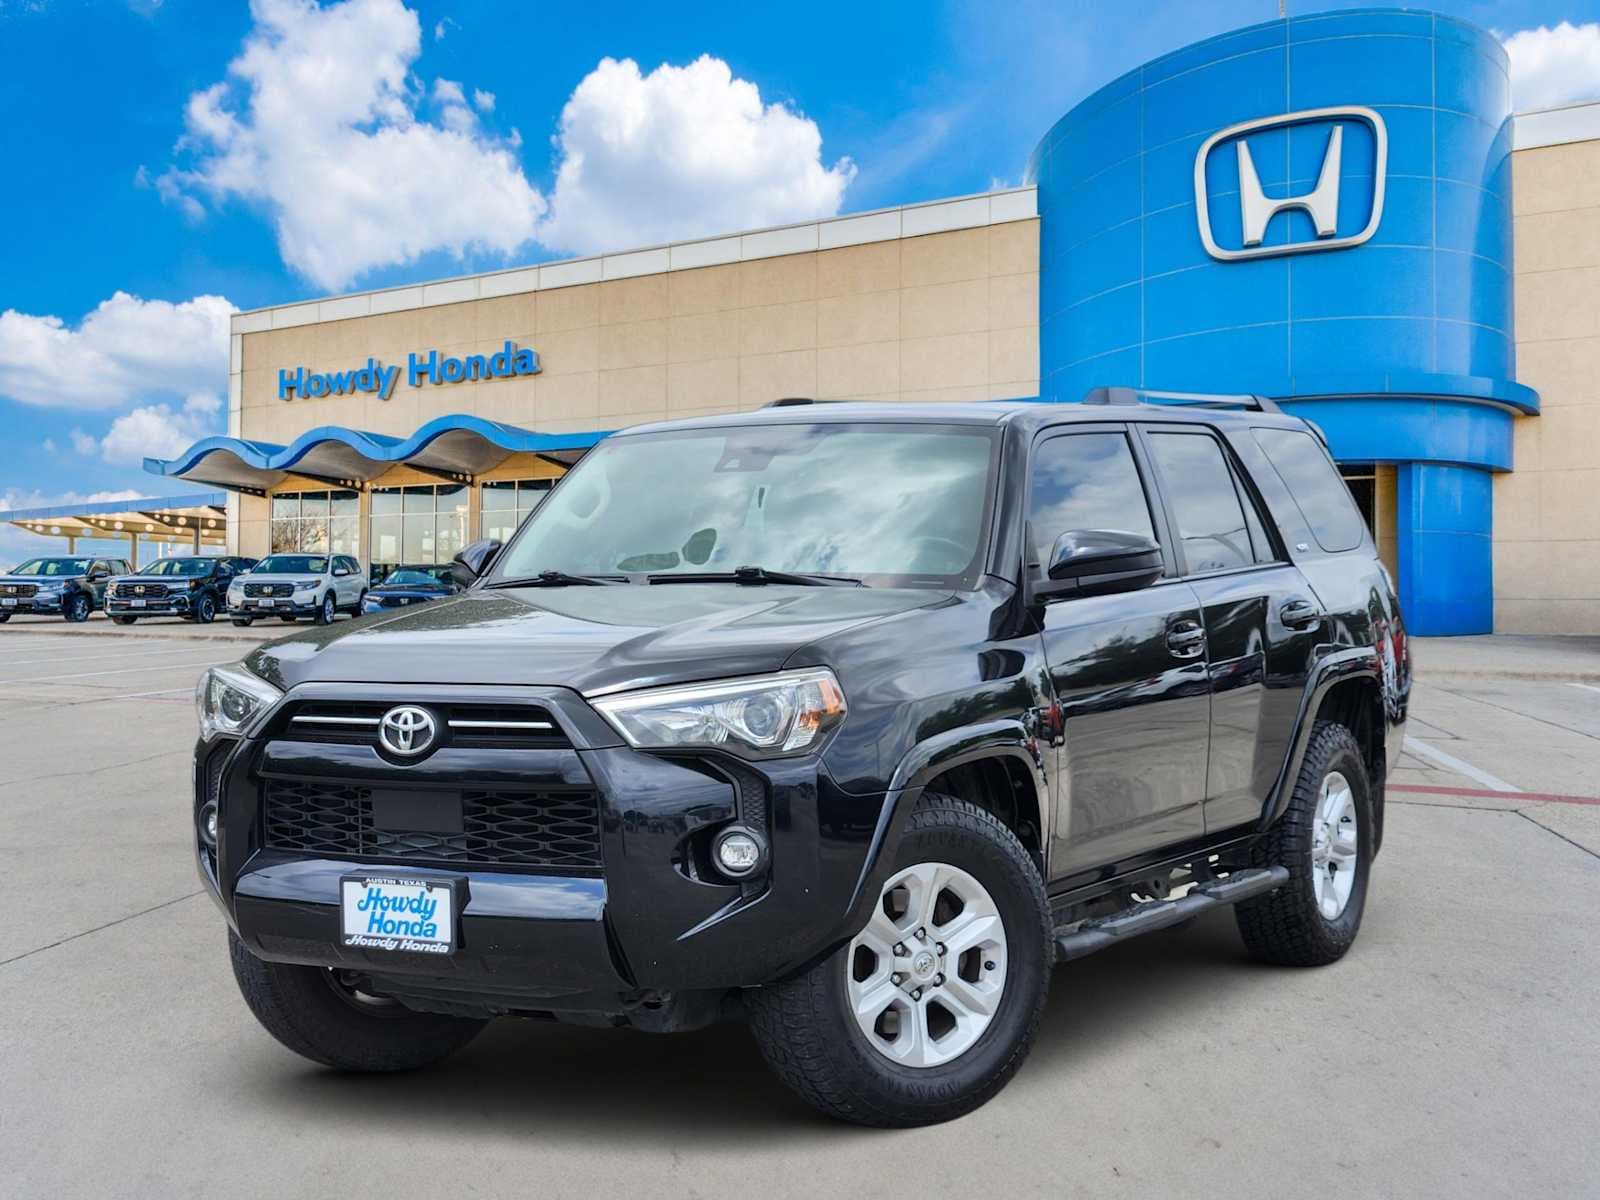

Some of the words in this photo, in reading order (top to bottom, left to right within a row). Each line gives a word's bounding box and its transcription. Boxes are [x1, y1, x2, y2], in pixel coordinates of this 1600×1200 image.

[278, 357, 400, 401] Howdy
[408, 340, 542, 388] Honda
[357, 888, 437, 919] Howdy
[368, 911, 438, 938] Honda
[345, 935, 399, 950] Howdy
[400, 940, 449, 953] Honda
